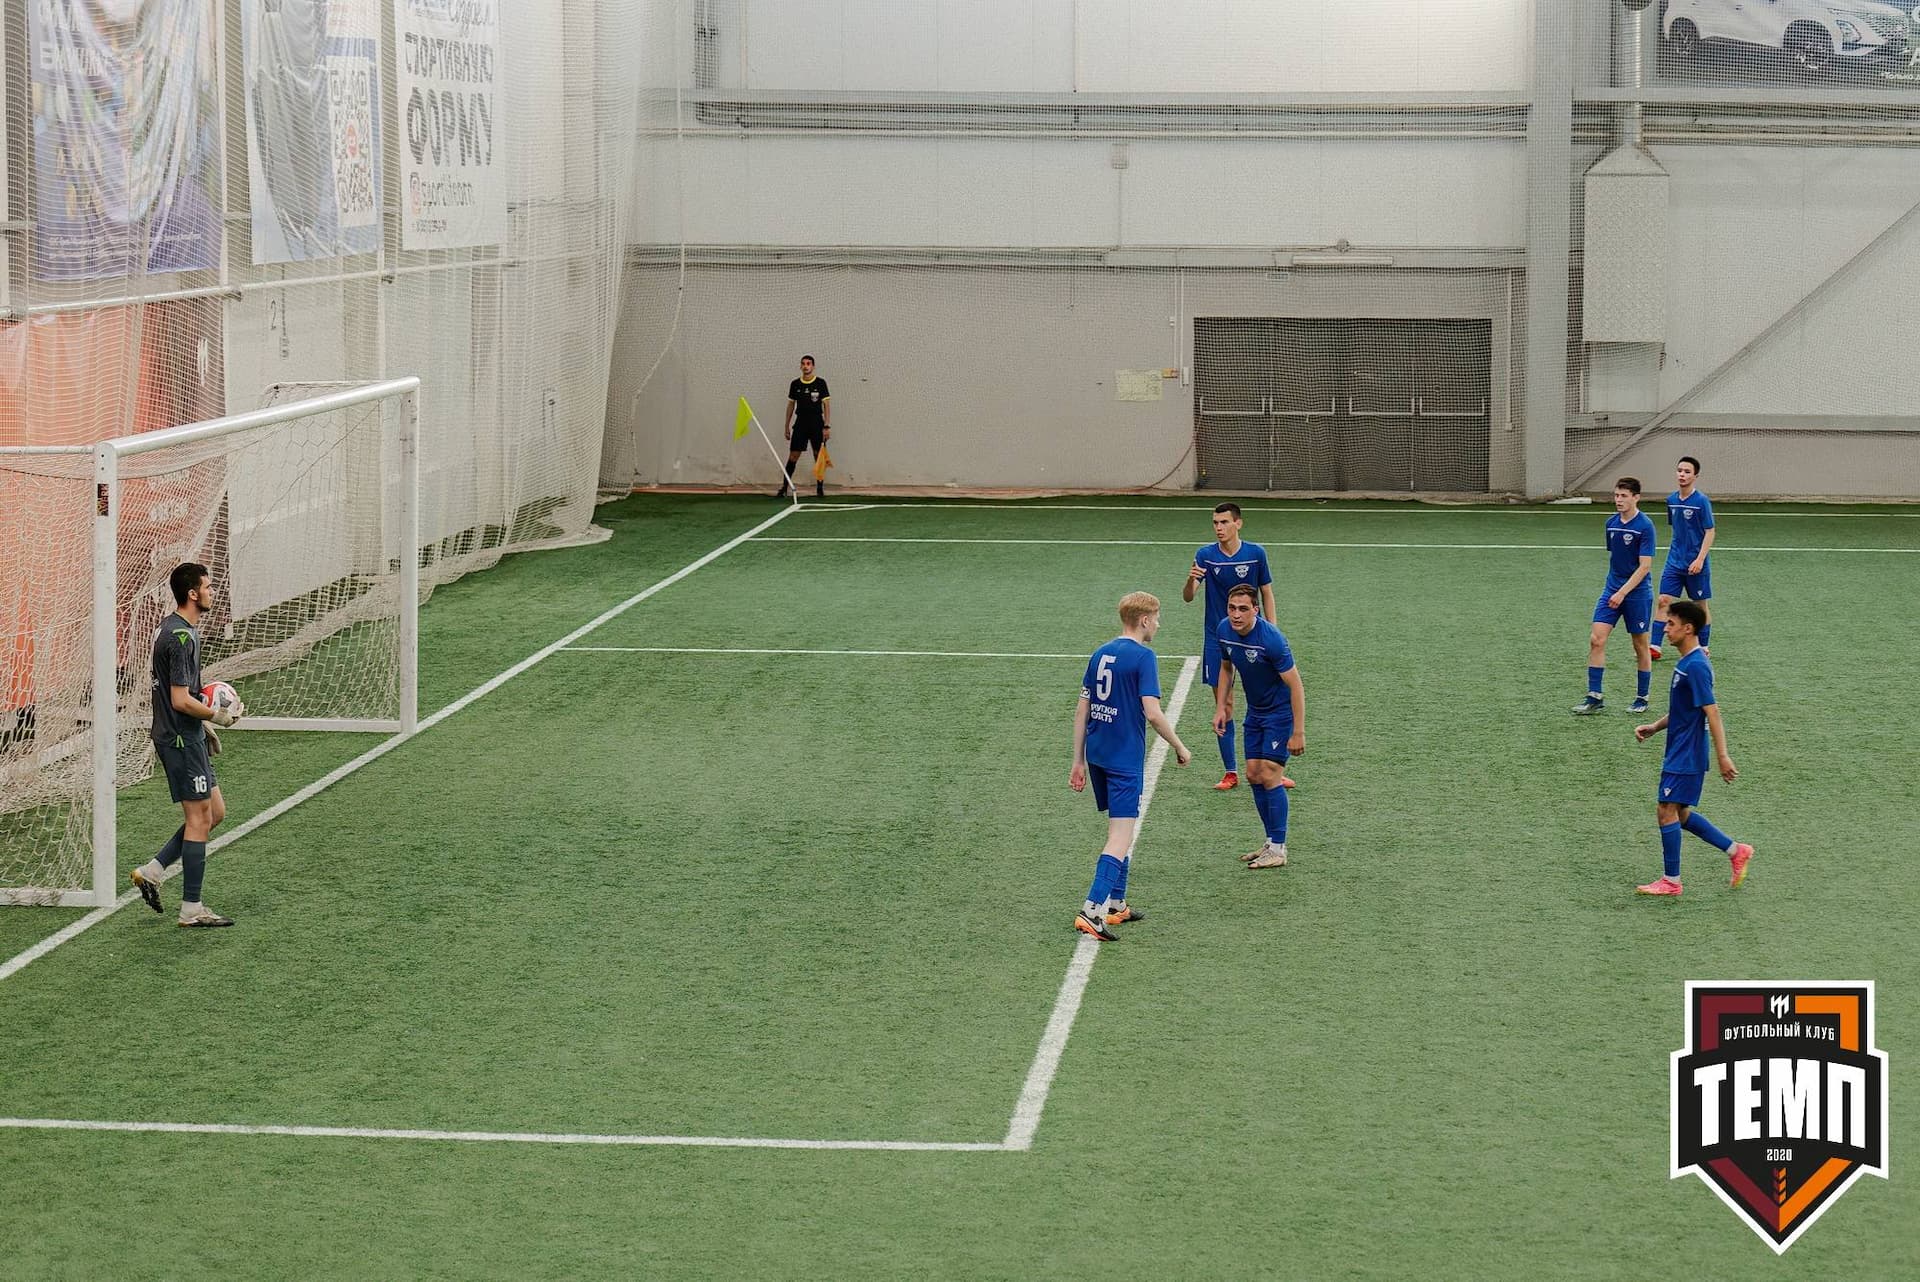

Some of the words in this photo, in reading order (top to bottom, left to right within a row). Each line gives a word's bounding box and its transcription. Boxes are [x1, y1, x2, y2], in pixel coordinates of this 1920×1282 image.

[407, 87, 492, 166] ФОРМУ
[1096, 654, 1116, 701] 5
[193, 775, 207, 793] 16
